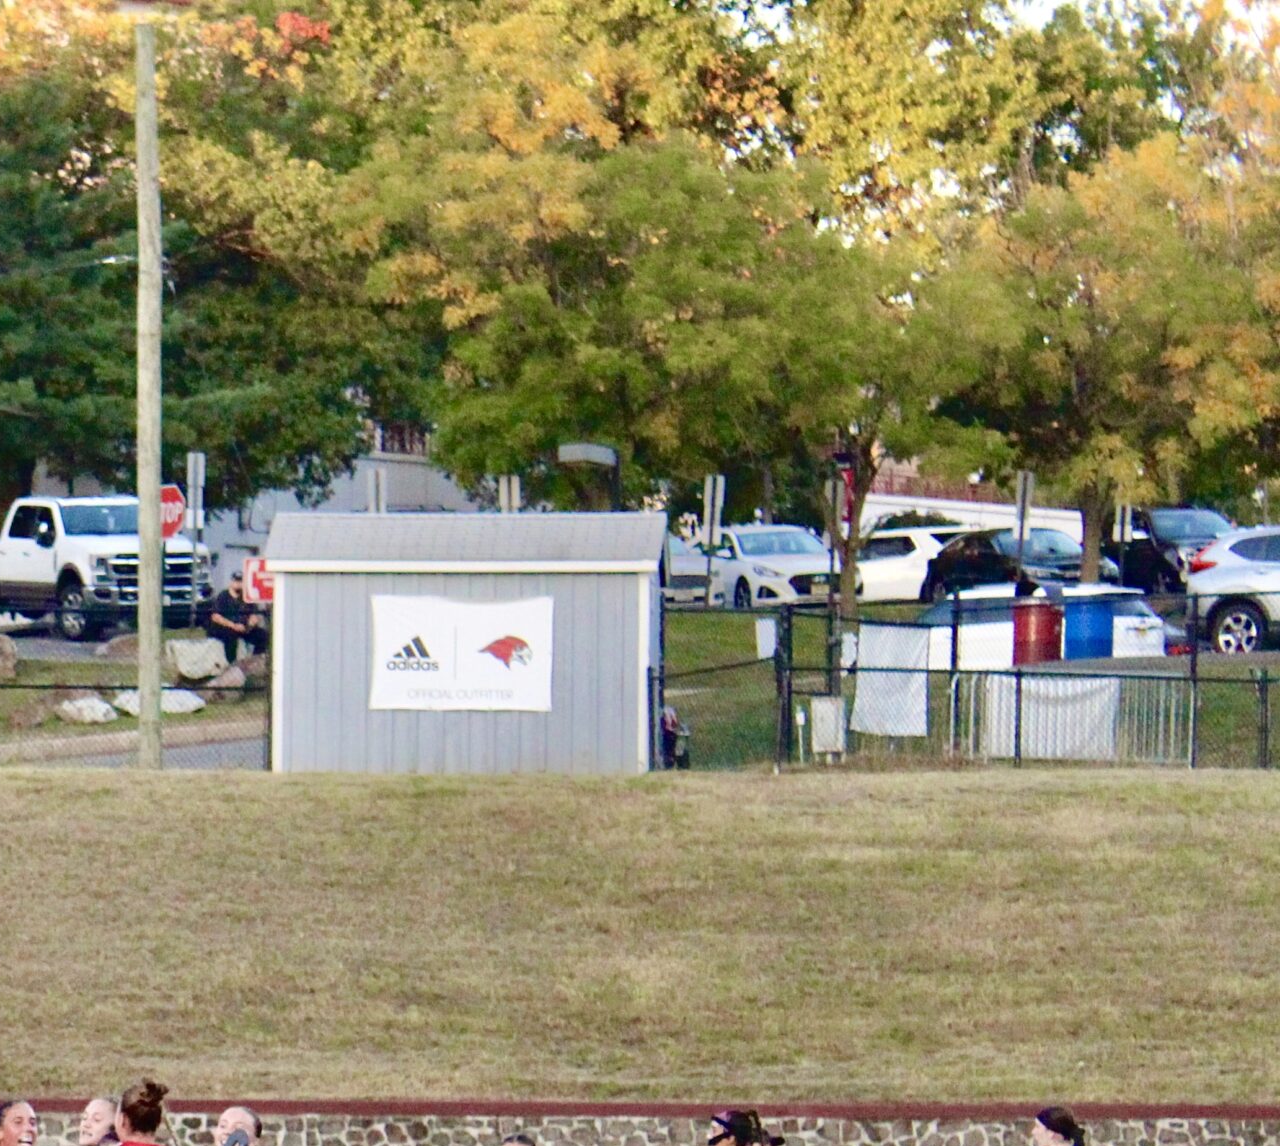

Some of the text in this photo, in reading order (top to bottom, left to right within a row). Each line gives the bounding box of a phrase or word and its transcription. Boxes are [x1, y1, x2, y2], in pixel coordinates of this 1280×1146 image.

[160, 501, 183, 523] TOP
[386, 658, 439, 672] adidas
[407, 688, 514, 700] OFFICIAL OUTFITTER
